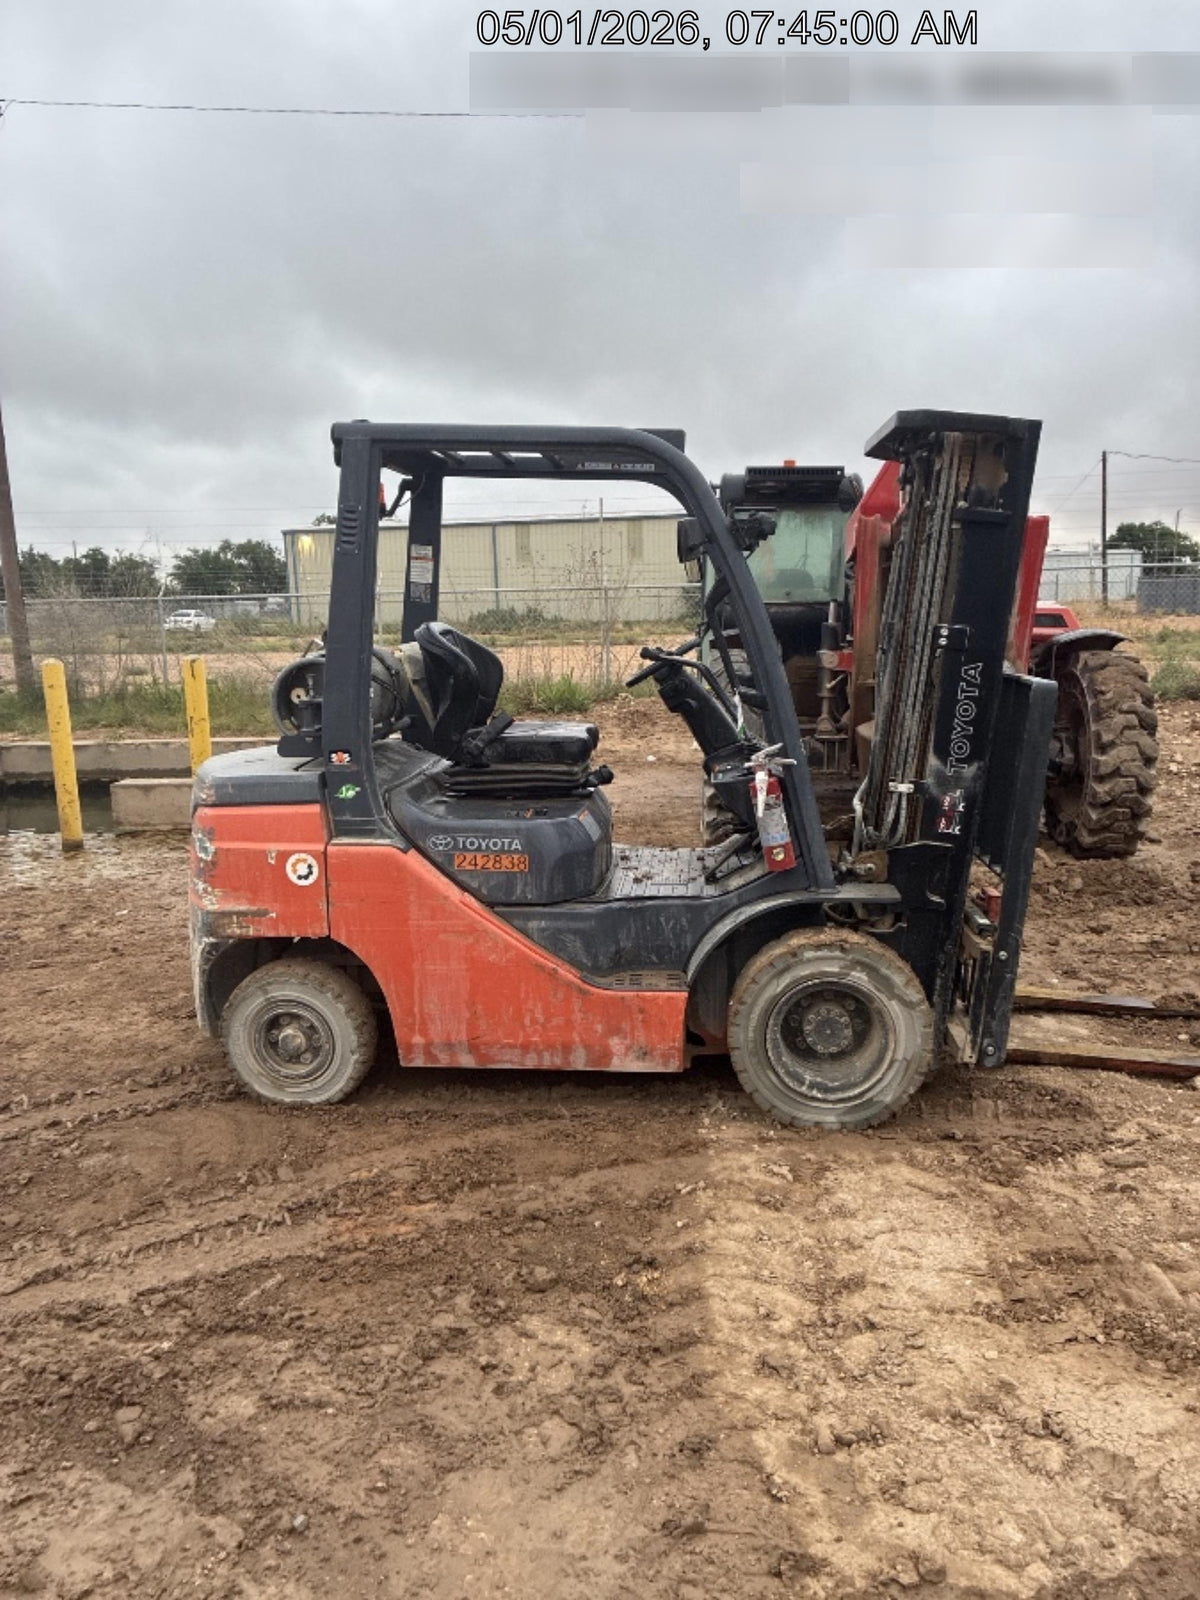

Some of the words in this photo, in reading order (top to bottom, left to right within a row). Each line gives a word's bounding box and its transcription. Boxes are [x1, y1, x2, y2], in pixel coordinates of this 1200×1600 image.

[946, 662, 983, 776] TOYOTA
[456, 836, 522, 851] TOYOTA
[455, 854, 529, 871] 242838
